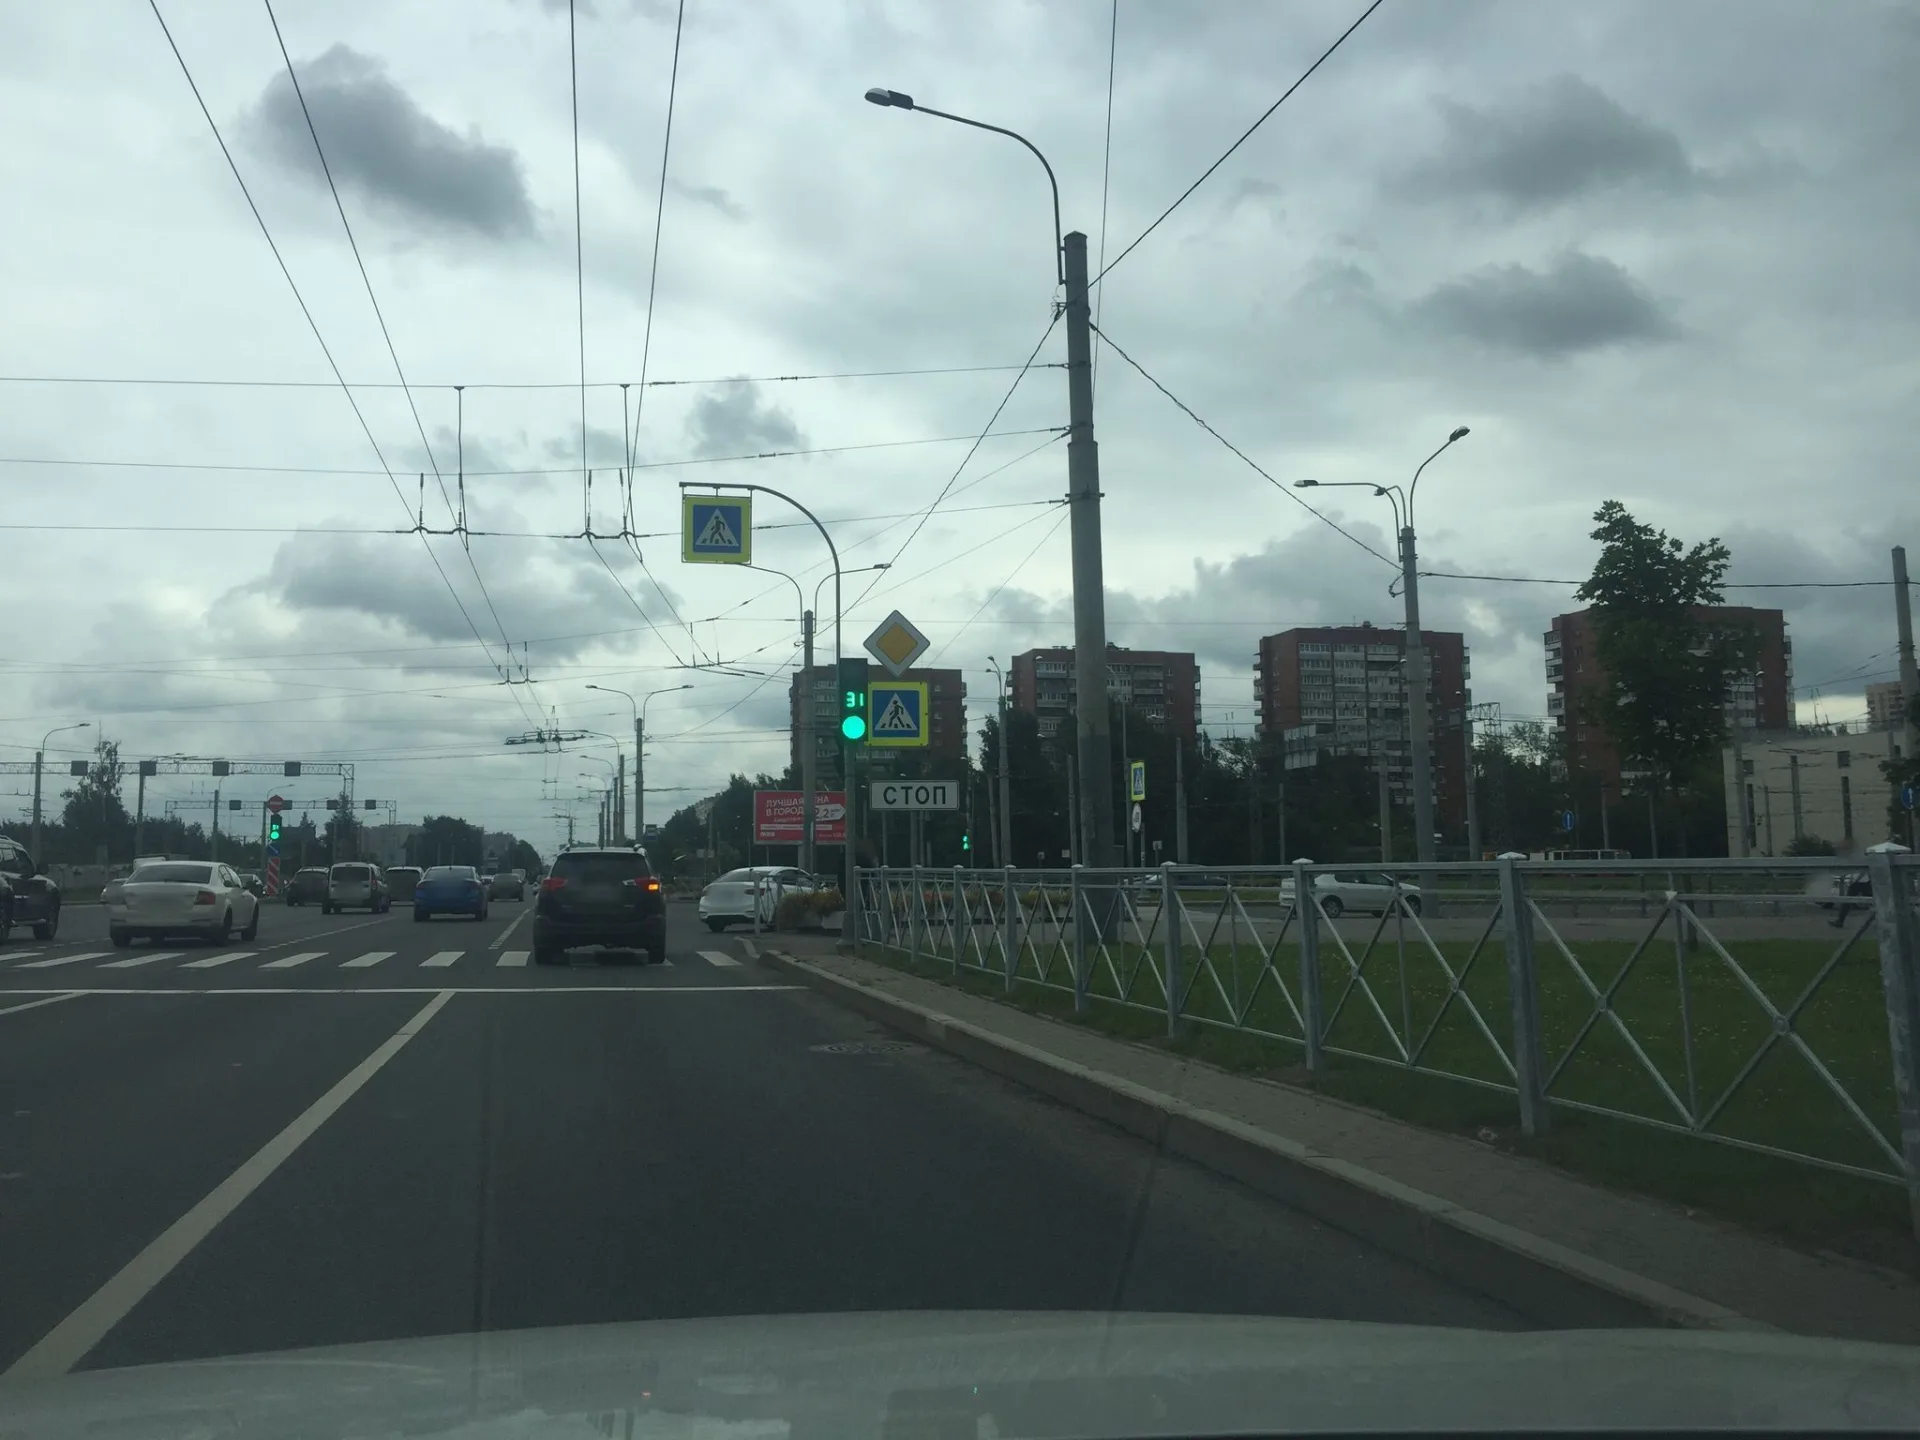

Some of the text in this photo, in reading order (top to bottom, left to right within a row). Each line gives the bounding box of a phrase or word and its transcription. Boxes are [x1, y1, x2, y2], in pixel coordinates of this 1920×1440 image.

[846, 691, 864, 708] 31
[883, 786, 946, 805] СТОП
[766, 808, 772, 816] В
